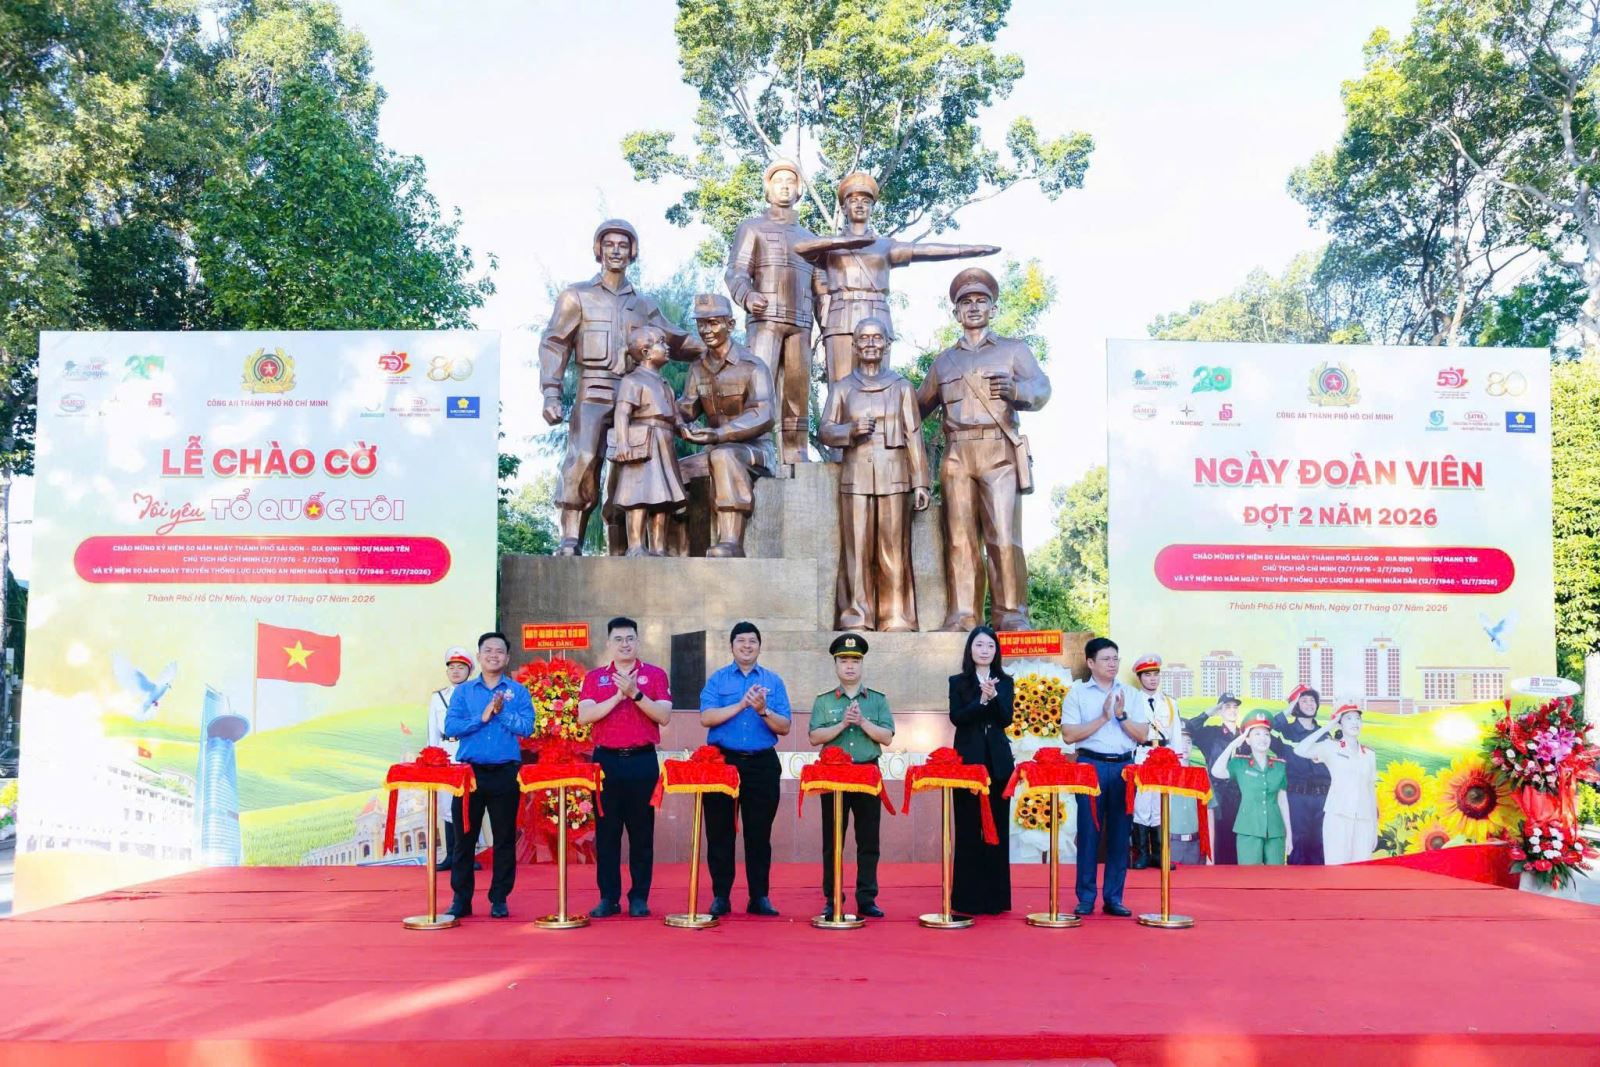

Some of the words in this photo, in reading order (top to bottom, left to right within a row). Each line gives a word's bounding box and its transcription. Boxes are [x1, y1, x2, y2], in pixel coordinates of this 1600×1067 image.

[162, 436, 204, 475] LỄ
[212, 440, 316, 476] CHÀO
[324, 440, 377, 476] CỜ
[1195, 450, 1290, 485] NGÀY
[1298, 452, 1396, 486] ĐOÀN
[1405, 454, 1483, 487] VIÊN
[134, 492, 168, 520] Tôi
[156, 502, 206, 535] yêu
[211, 488, 252, 520] TỔ
[258, 492, 346, 521] QUỐC
[351, 495, 405, 521] TÔI
[1242, 504, 1293, 529] ĐỢT
[1299, 507, 1313, 524] 2
[1319, 502, 1372, 525] NĂM
[1378, 508, 1438, 526] 2026
